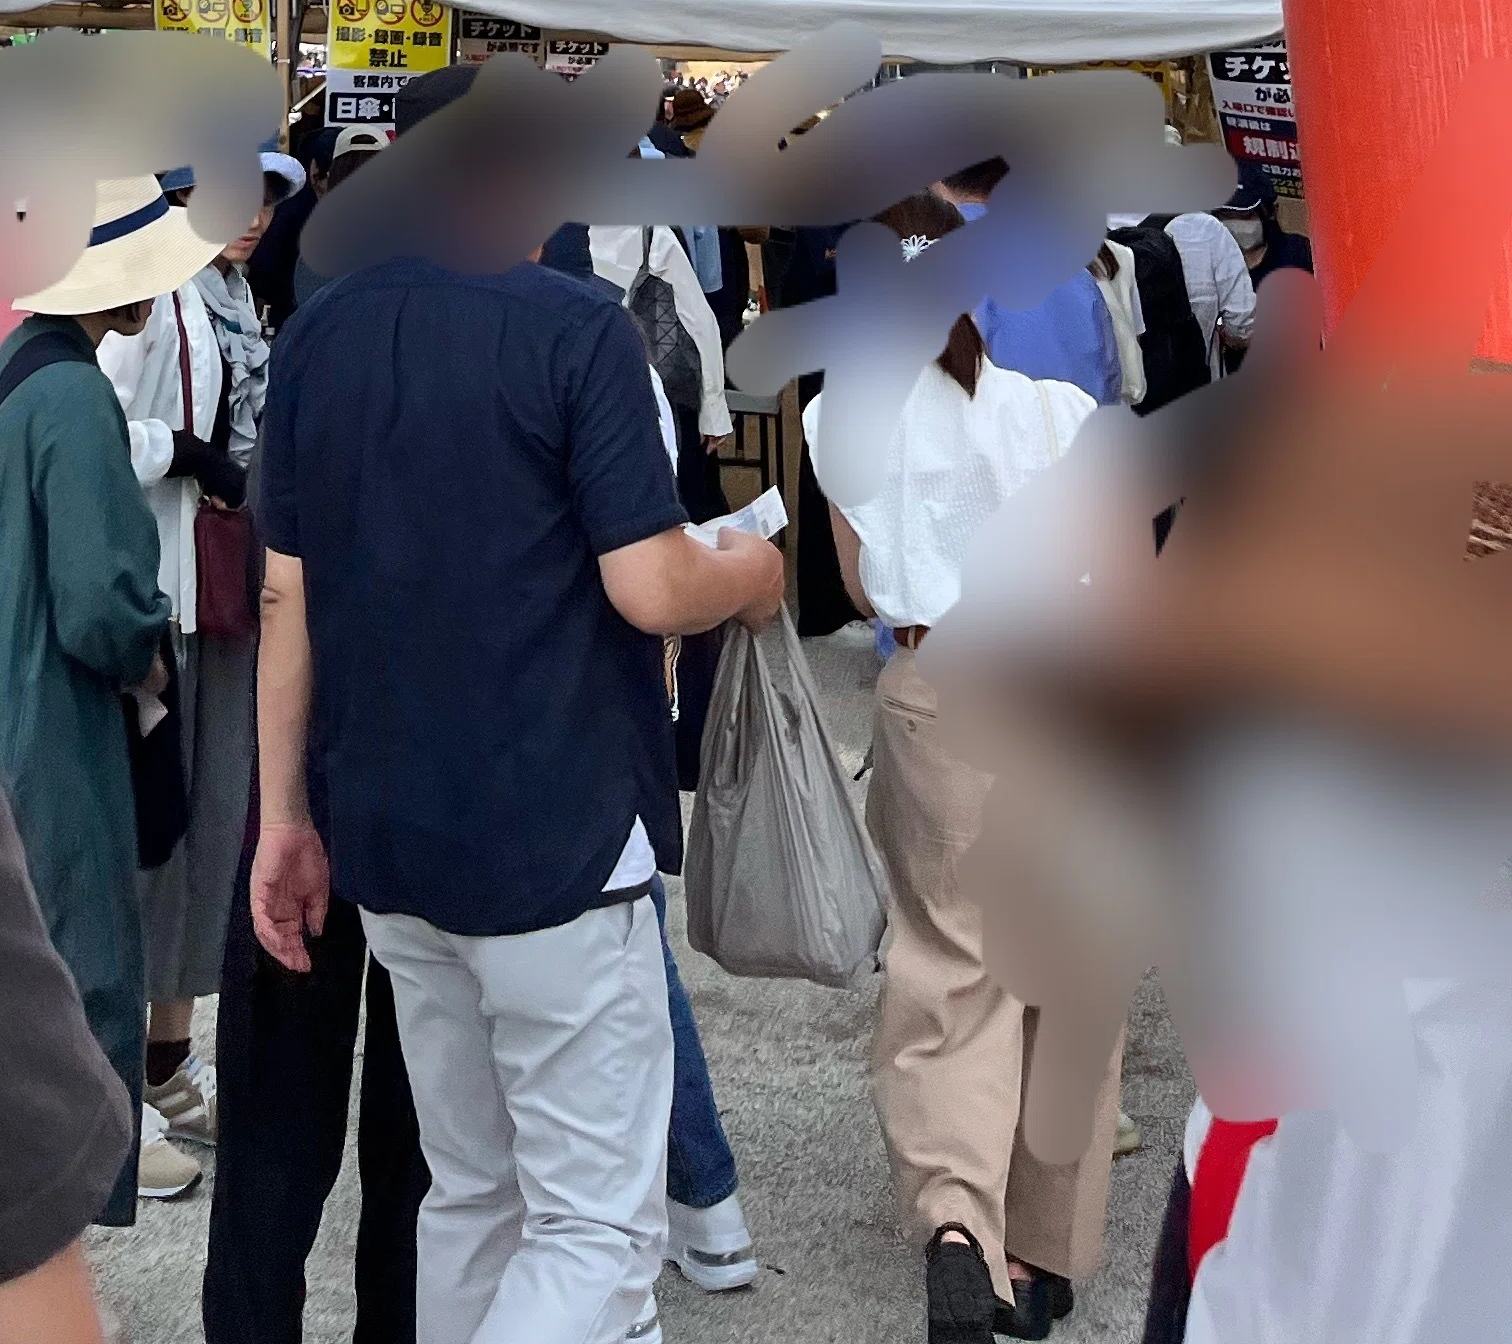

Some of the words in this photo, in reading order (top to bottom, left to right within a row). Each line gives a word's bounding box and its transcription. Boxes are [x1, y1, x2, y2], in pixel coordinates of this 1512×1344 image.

[470, 20, 532, 38] チケット
[555, 41, 603, 54] チケット
[369, 47, 408, 68] 禁止
[337, 97, 395, 120] 日傘・
